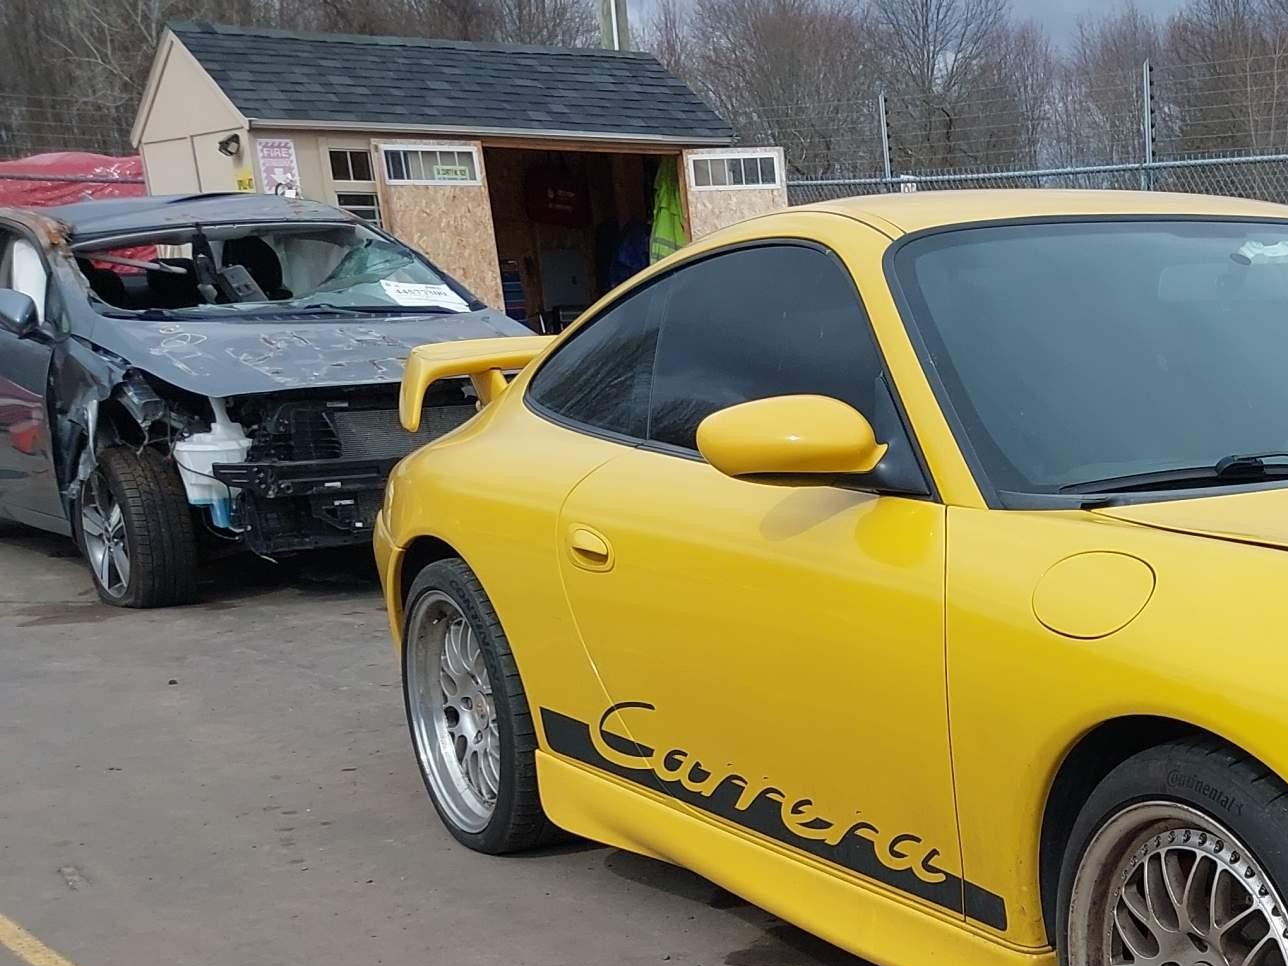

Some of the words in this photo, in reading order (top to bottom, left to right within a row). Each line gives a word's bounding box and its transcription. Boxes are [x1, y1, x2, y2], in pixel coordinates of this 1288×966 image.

[263, 147, 289, 158] FIRE
[590, 700, 947, 884] Carrera
[1167, 768, 1237, 813] Continental
